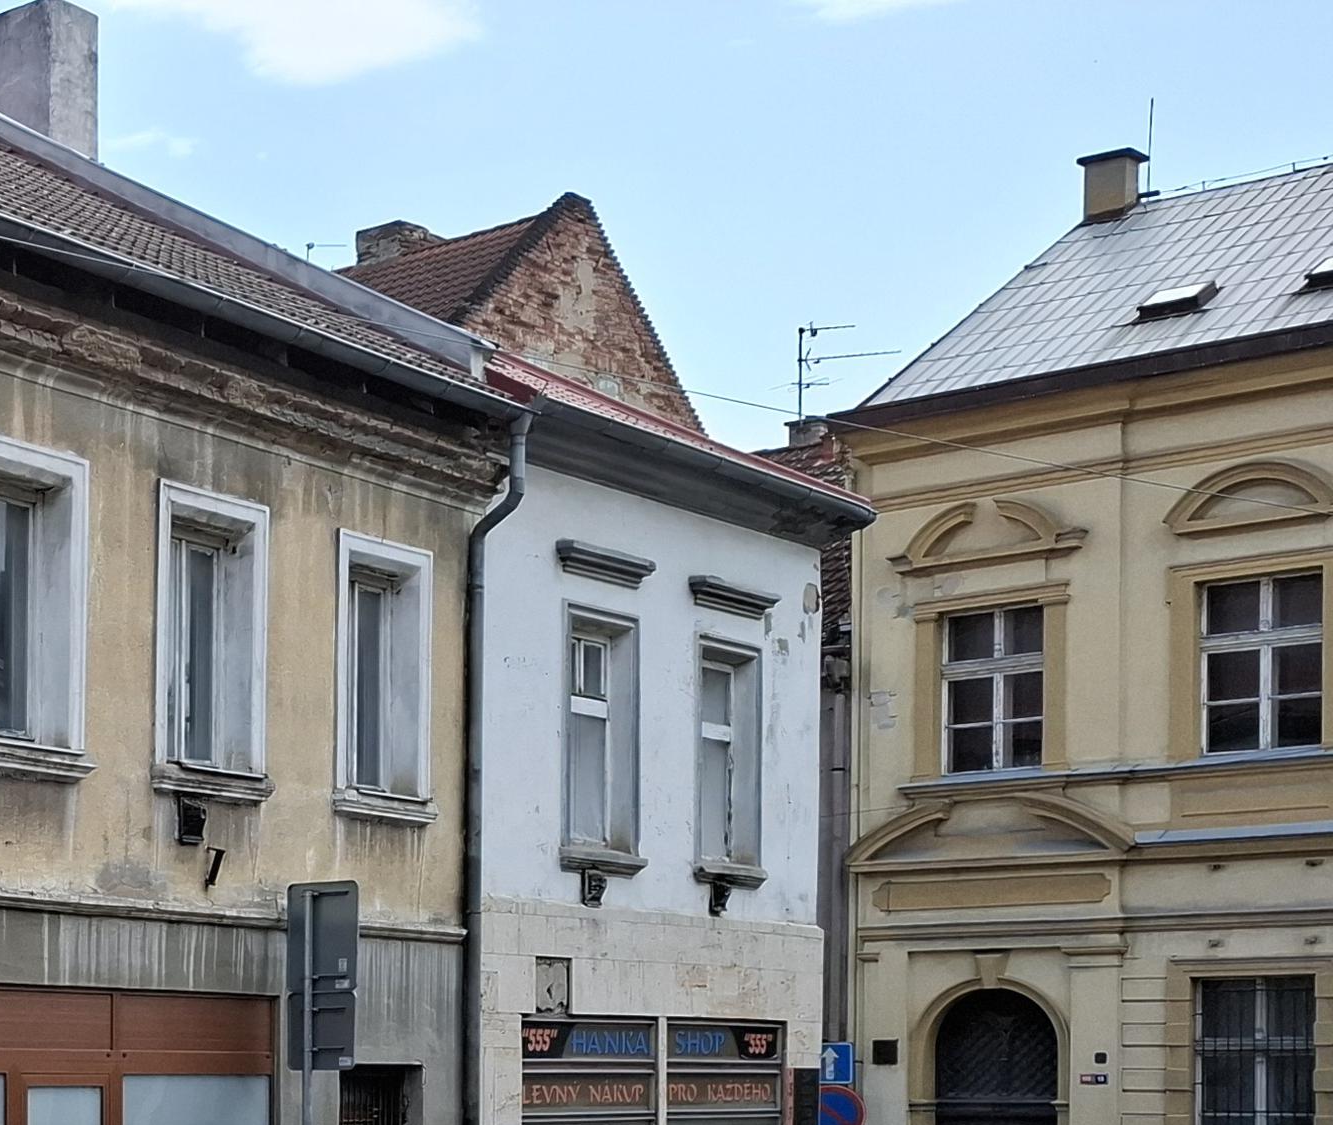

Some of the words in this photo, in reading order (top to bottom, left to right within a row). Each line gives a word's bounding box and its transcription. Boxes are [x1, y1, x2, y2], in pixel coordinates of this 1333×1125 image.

[572, 1029, 650, 1056] HANKA
[675, 1031, 725, 1055] SHOP
[521, 1080, 581, 1104] LEVNÝ
[589, 1079, 644, 1104] NÁKUP
[668, 1083, 698, 1102] PRO
[707, 1080, 771, 1102] KAŽDÉHO
